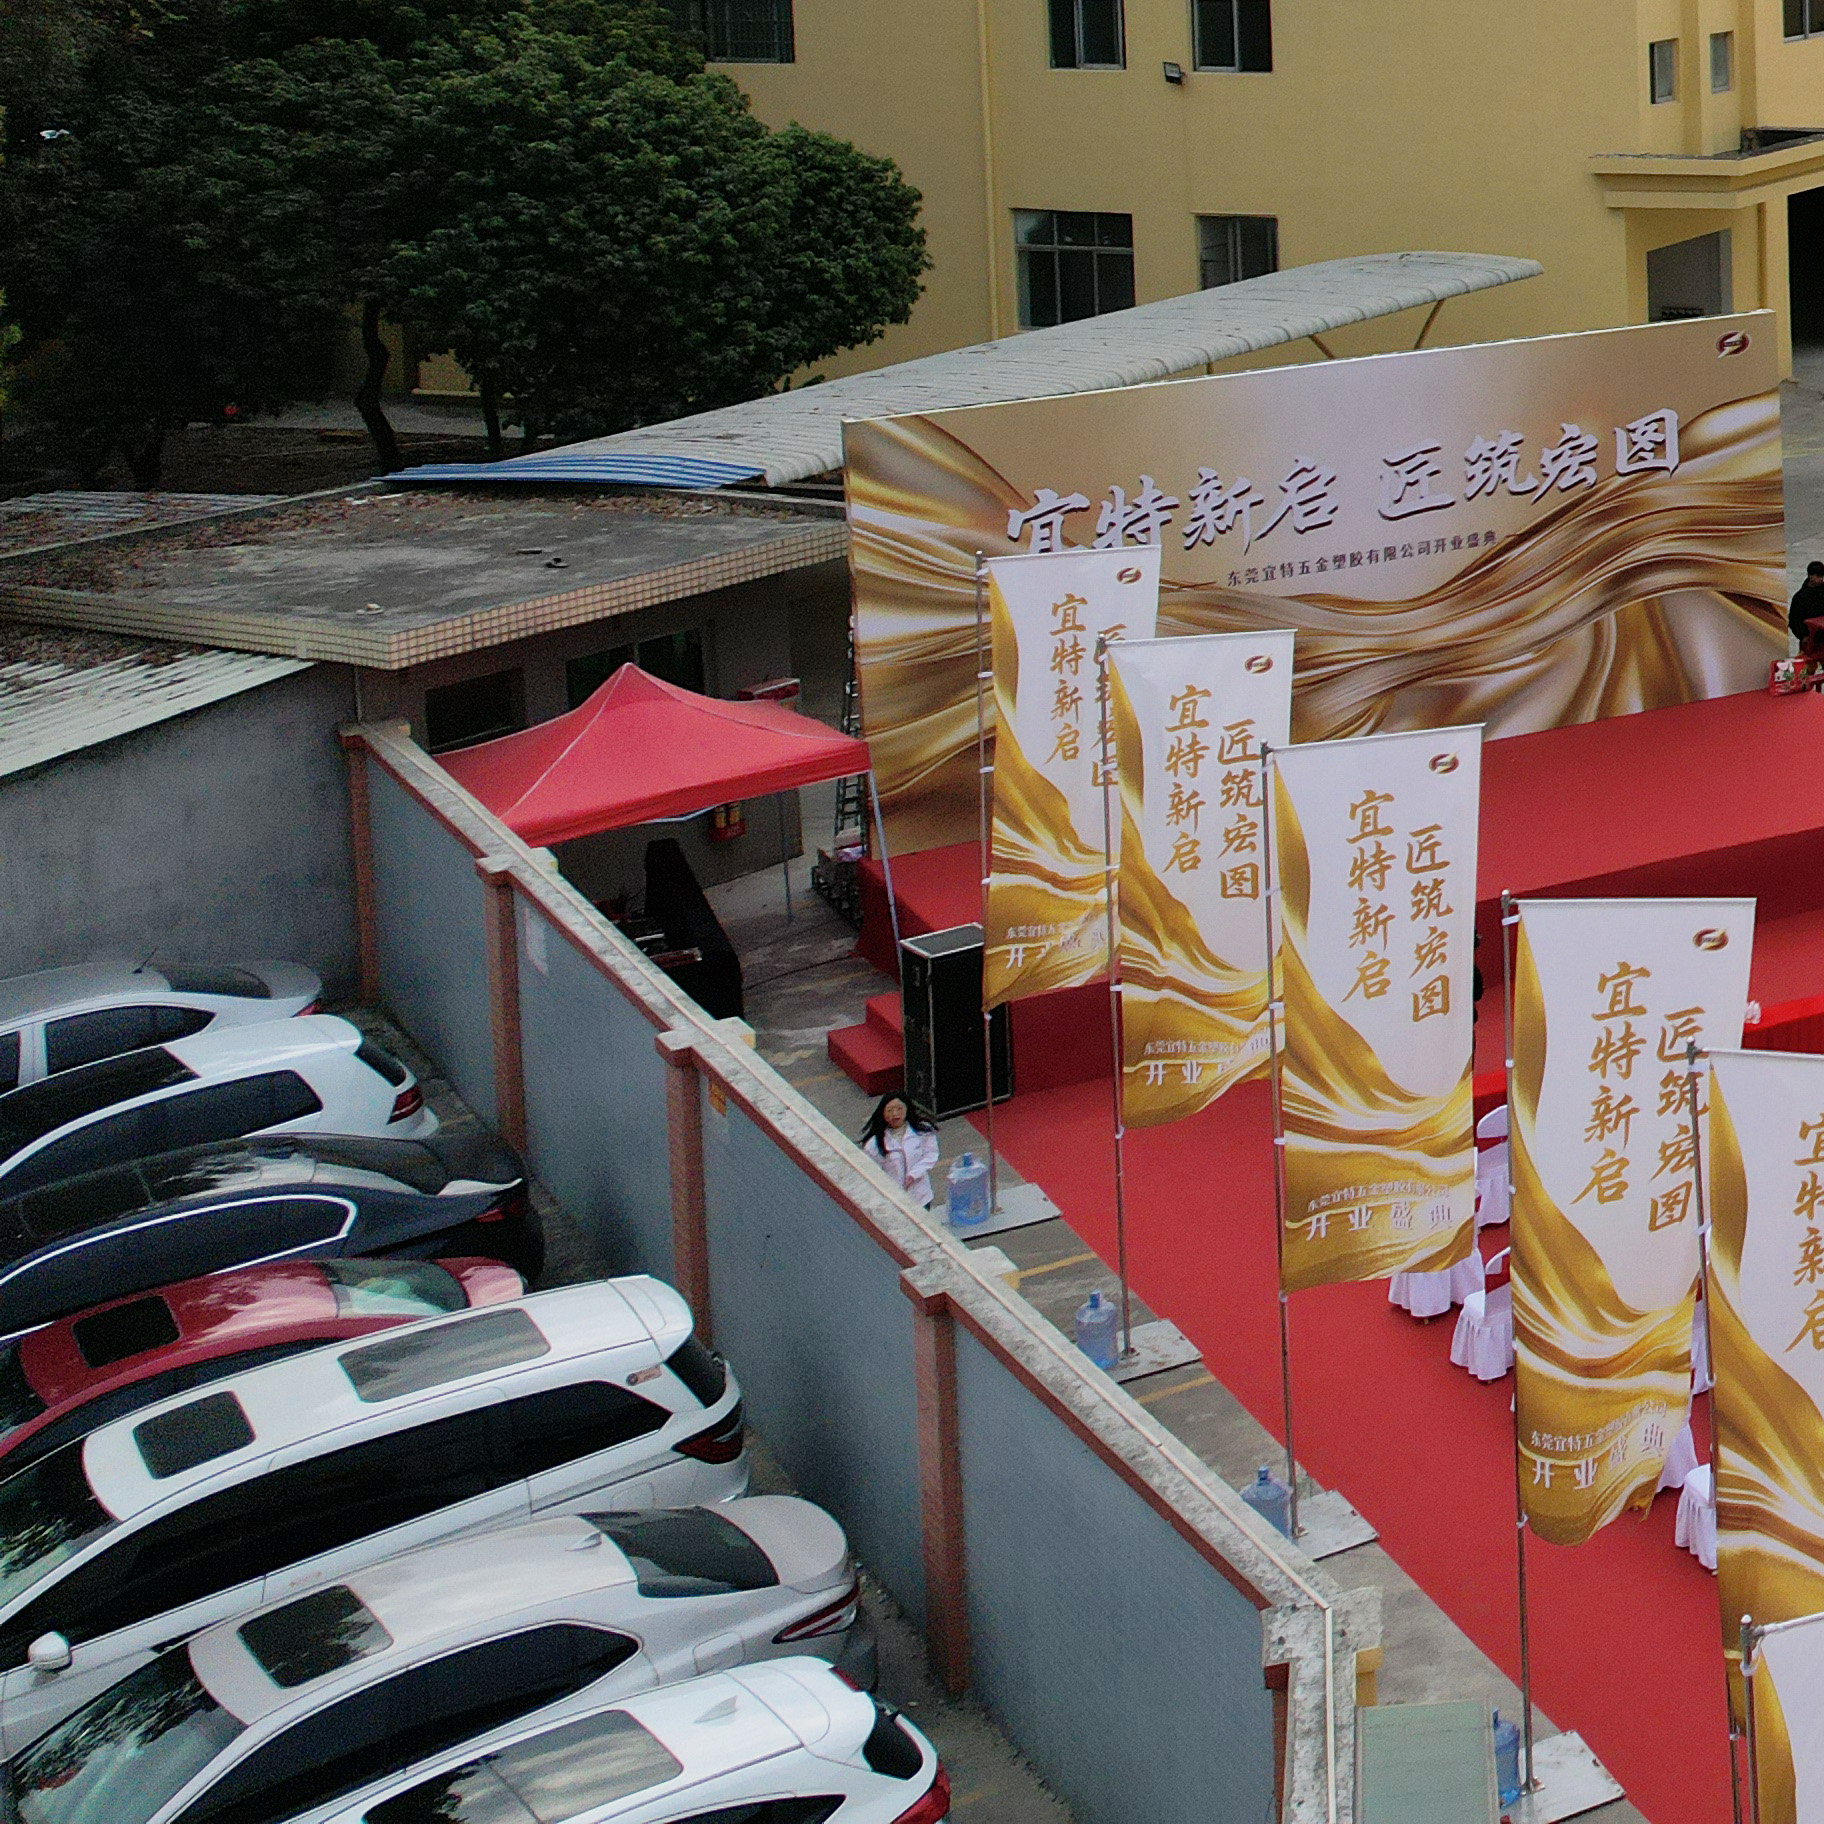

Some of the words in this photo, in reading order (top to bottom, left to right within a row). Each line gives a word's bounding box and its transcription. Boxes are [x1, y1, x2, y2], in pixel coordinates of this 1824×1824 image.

[1006, 456, 1340, 557] 宜特新启
[1378, 407, 1682, 522] 匠筑宏图
[1227, 529, 1498, 587] 东莞宜特五金塑胶有限公司开业盛典
[1044, 593, 1088, 765] 宜特新启
[1162, 685, 1212, 875] 宜特新启
[1217, 721, 1264, 900] 匠筑宏图
[1341, 790, 1397, 1003] 宜特新启
[1405, 824, 1455, 1022] 匠筑宏图
[1570, 961, 1652, 1205] 宜特新启
[1647, 1006, 1711, 1232] 匠筑宏图
